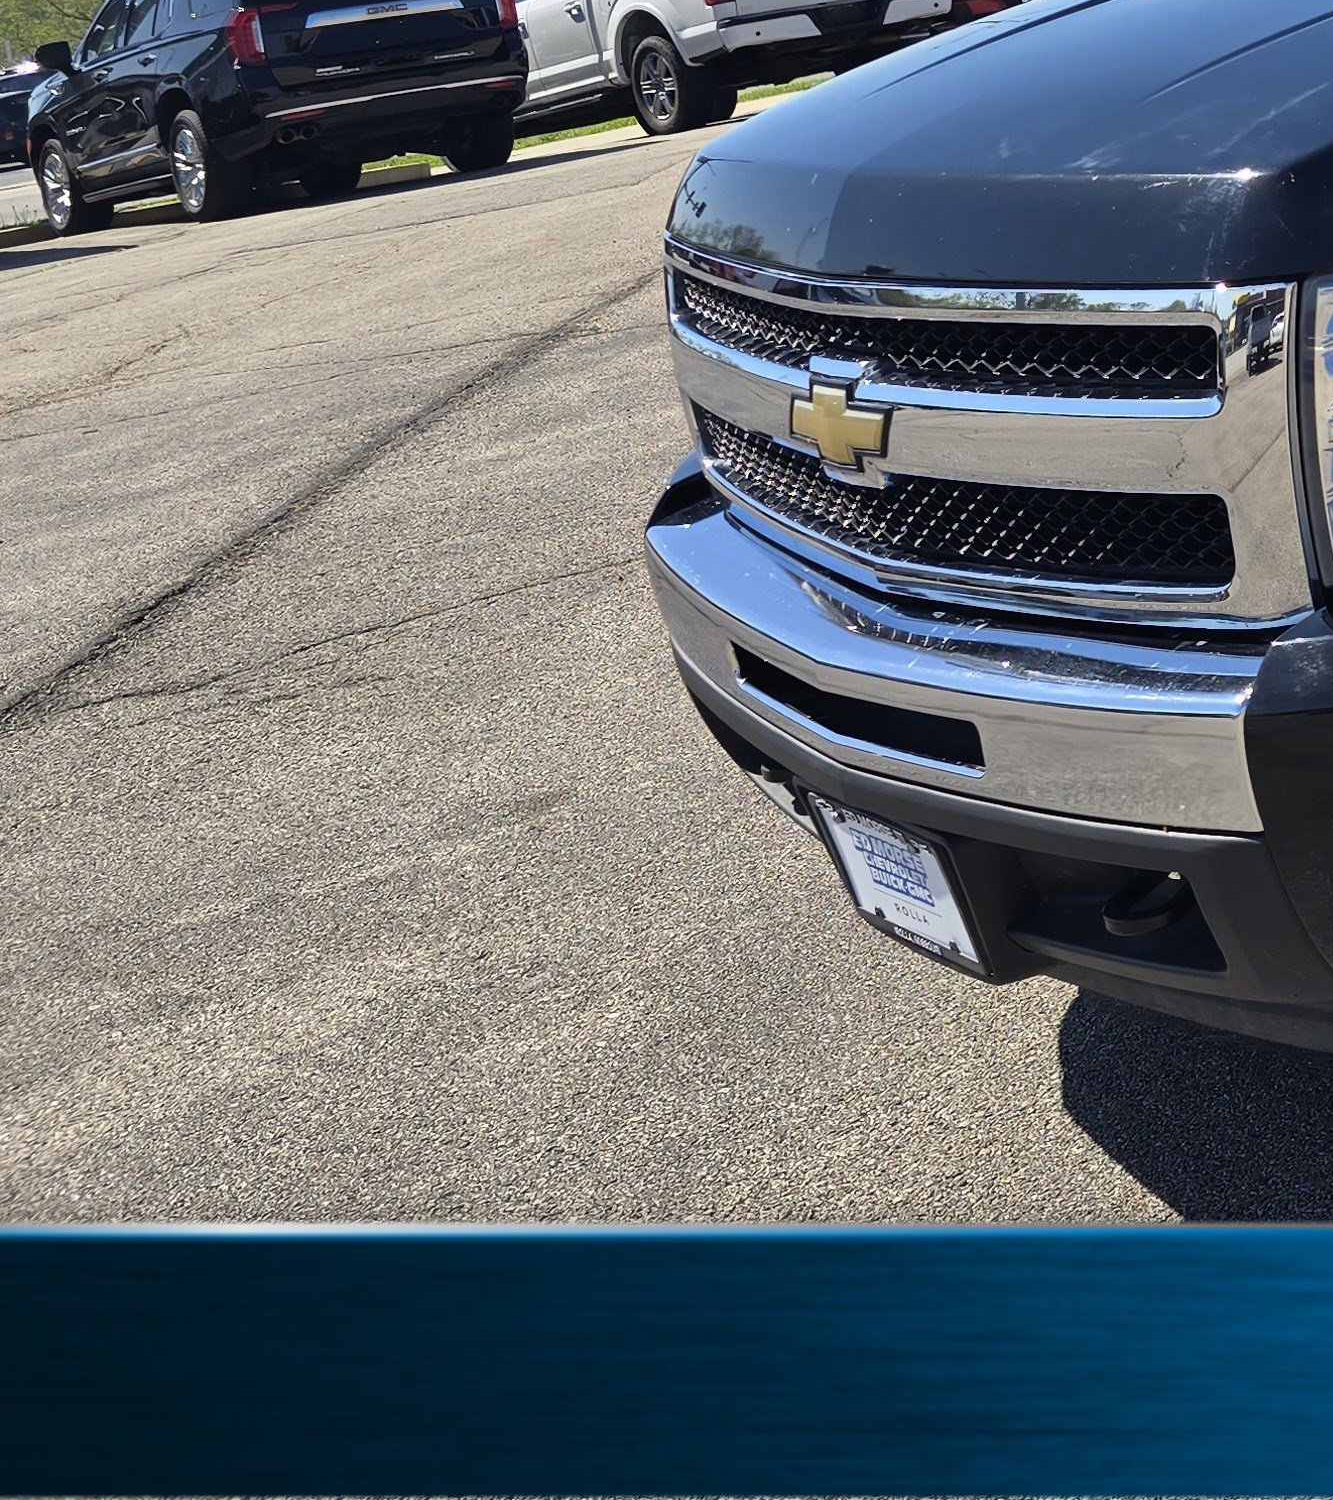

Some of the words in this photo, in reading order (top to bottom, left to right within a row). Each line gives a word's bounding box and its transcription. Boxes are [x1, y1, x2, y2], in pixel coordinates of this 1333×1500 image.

[365, 3, 409, 16] GMC
[853, 830, 872, 852] ED
[873, 837, 925, 876] MORSE
[863, 851, 928, 887] CHEVROLET
[893, 902, 931, 926] ROLLA
